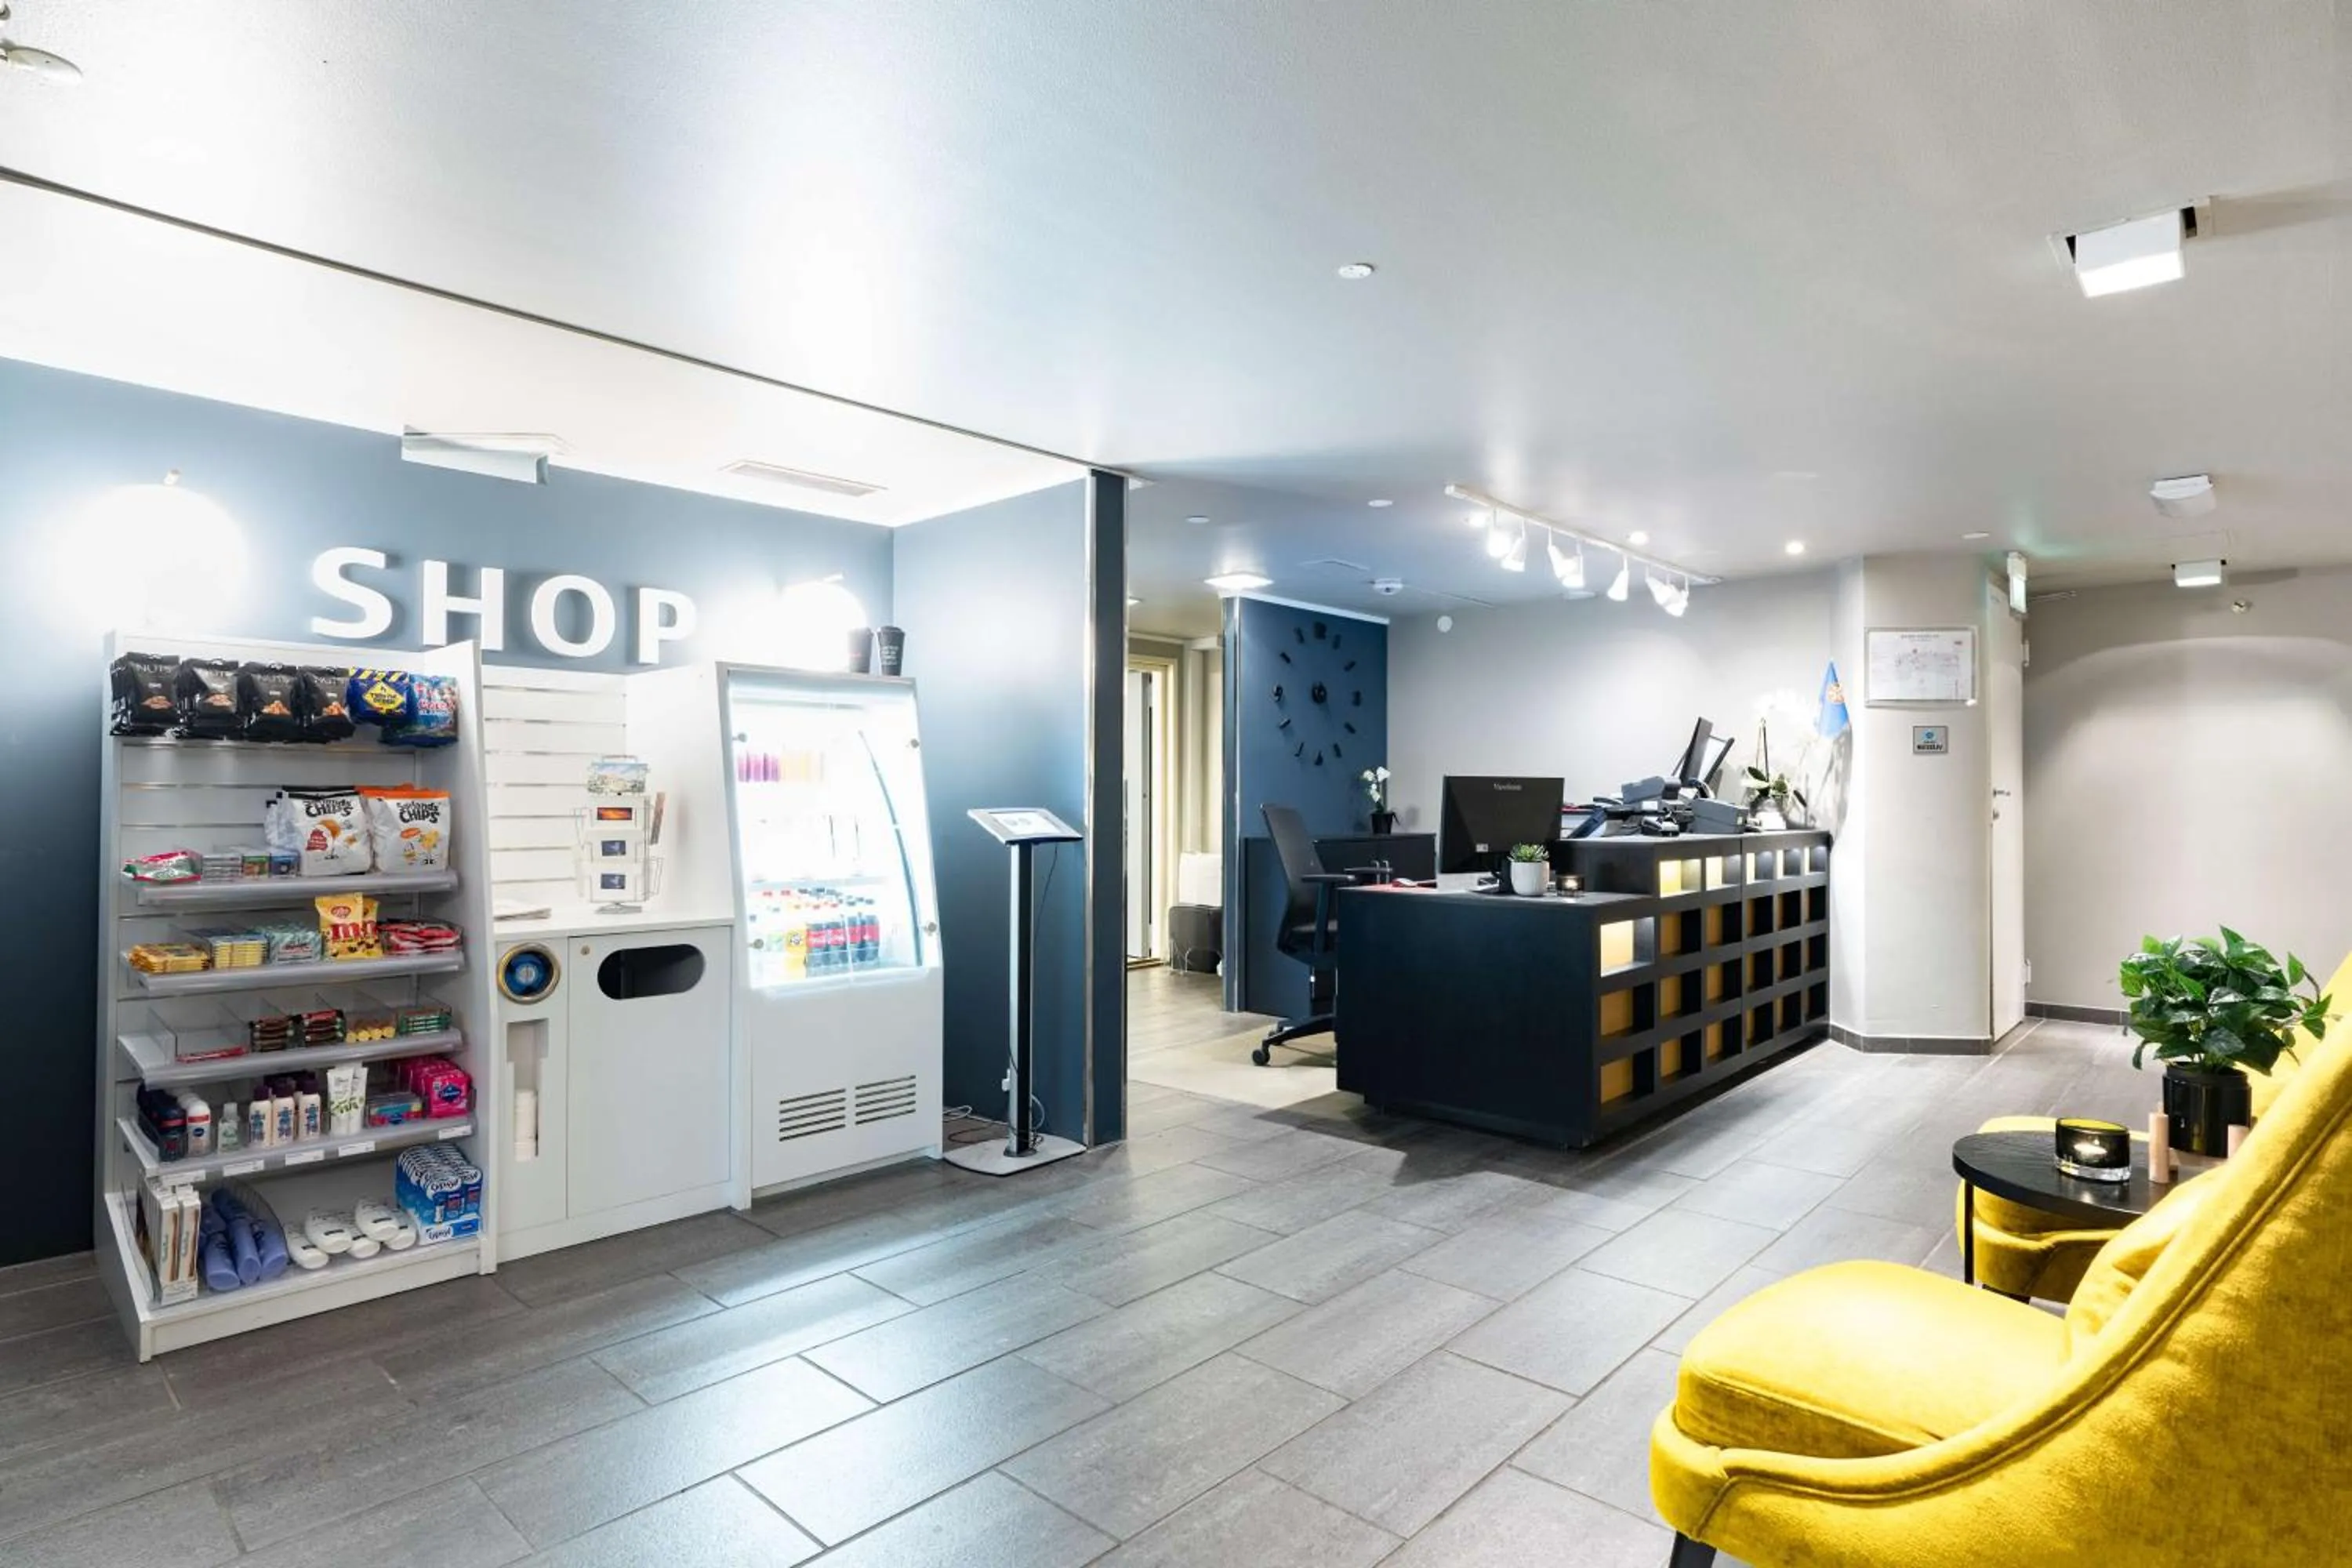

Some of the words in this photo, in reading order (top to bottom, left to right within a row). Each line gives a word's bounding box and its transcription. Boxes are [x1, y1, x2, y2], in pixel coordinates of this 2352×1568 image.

[310, 546, 697, 664] SHOP
[136, 664, 172, 673] NUTS
[1272, 683, 1283, 702] 9
[399, 808, 440, 823] CHIPS
